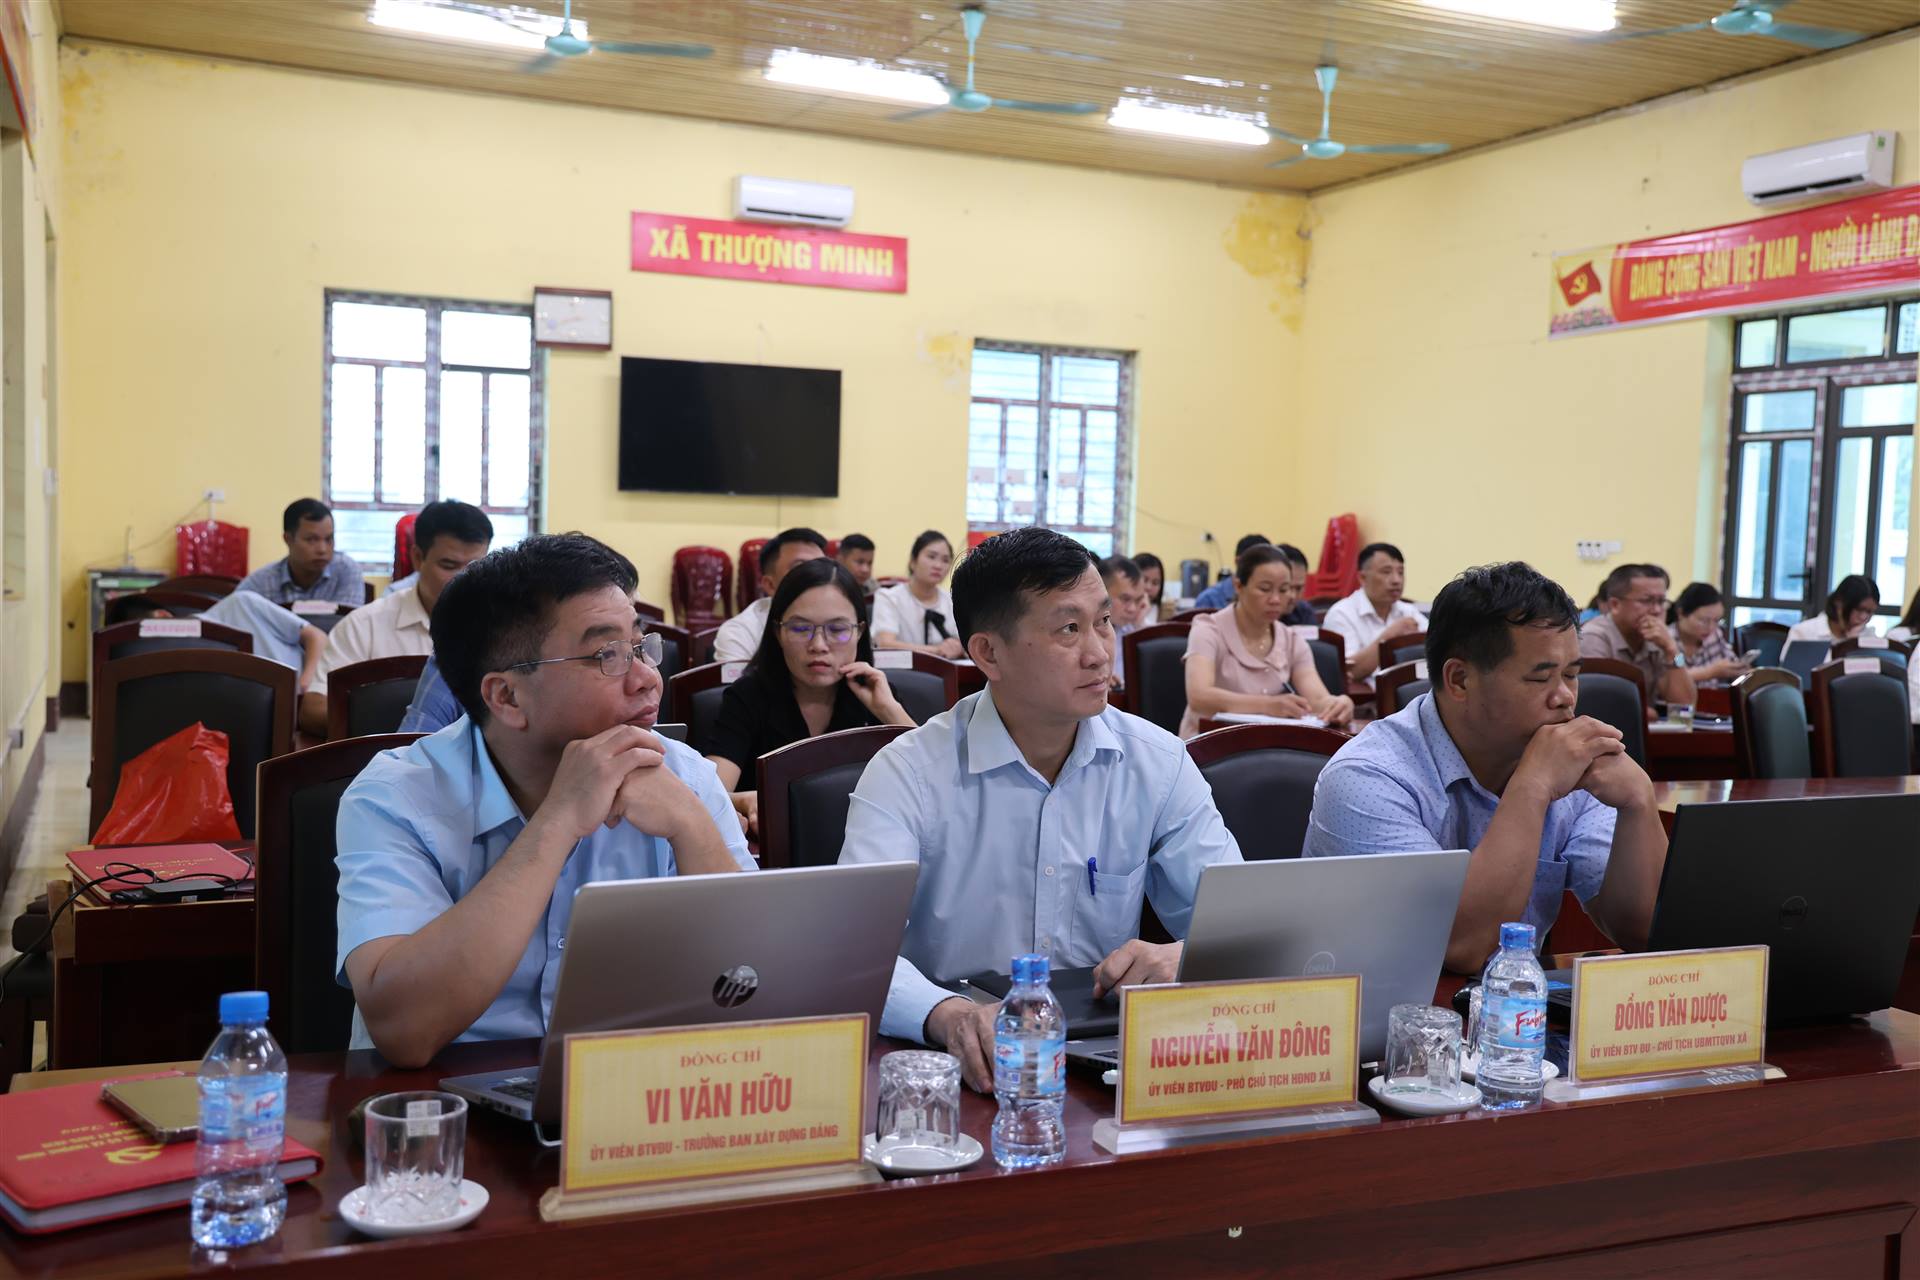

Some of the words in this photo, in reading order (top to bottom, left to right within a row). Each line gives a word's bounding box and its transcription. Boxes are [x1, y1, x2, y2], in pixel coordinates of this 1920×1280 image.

[650, 224, 690, 260] XÃ
[697, 232, 812, 272] THƯỢNG
[820, 243, 894, 277] MINH
[1762, 235, 1798, 280] NAM
[1680, 970, 1701, 983] CHÍ
[1253, 1000, 1276, 1015] CHÍ
[1658, 992, 1687, 1027] VĂN
[1690, 992, 1728, 1029] DƯỢC
[732, 1046, 761, 1063] CHÍ
[1150, 1022, 1230, 1069] NGUYỄN
[1236, 1024, 1274, 1062] VĂN
[1279, 1020, 1331, 1059] ĐÔNG
[1590, 1044, 1601, 1058] ỦY
[1603, 1043, 1622, 1057] VIÊN
[1623, 1043, 1638, 1055] BTV
[1657, 1037, 1673, 1052] CHỦ
[1675, 1037, 1693, 1051] TỊCH
[646, 1087, 671, 1124] VI
[680, 1077, 732, 1122] VĂN
[740, 1072, 792, 1116] HỮU
[1148, 1081, 1161, 1097] ỦY
[1163, 1080, 1185, 1095] VIÊN
[1227, 1075, 1245, 1090] PHÓ
[1247, 1072, 1266, 1089] CHỦ
[1268, 1073, 1289, 1089] TỊCH
[591, 1144, 605, 1161] ỦY
[608, 1142, 634, 1159] VIÊN
[684, 1132, 727, 1152] TRƯỞNG
[729, 1133, 752, 1148] BAN
[755, 1129, 776, 1145] XÂY
[778, 1127, 807, 1144] DỰNG
